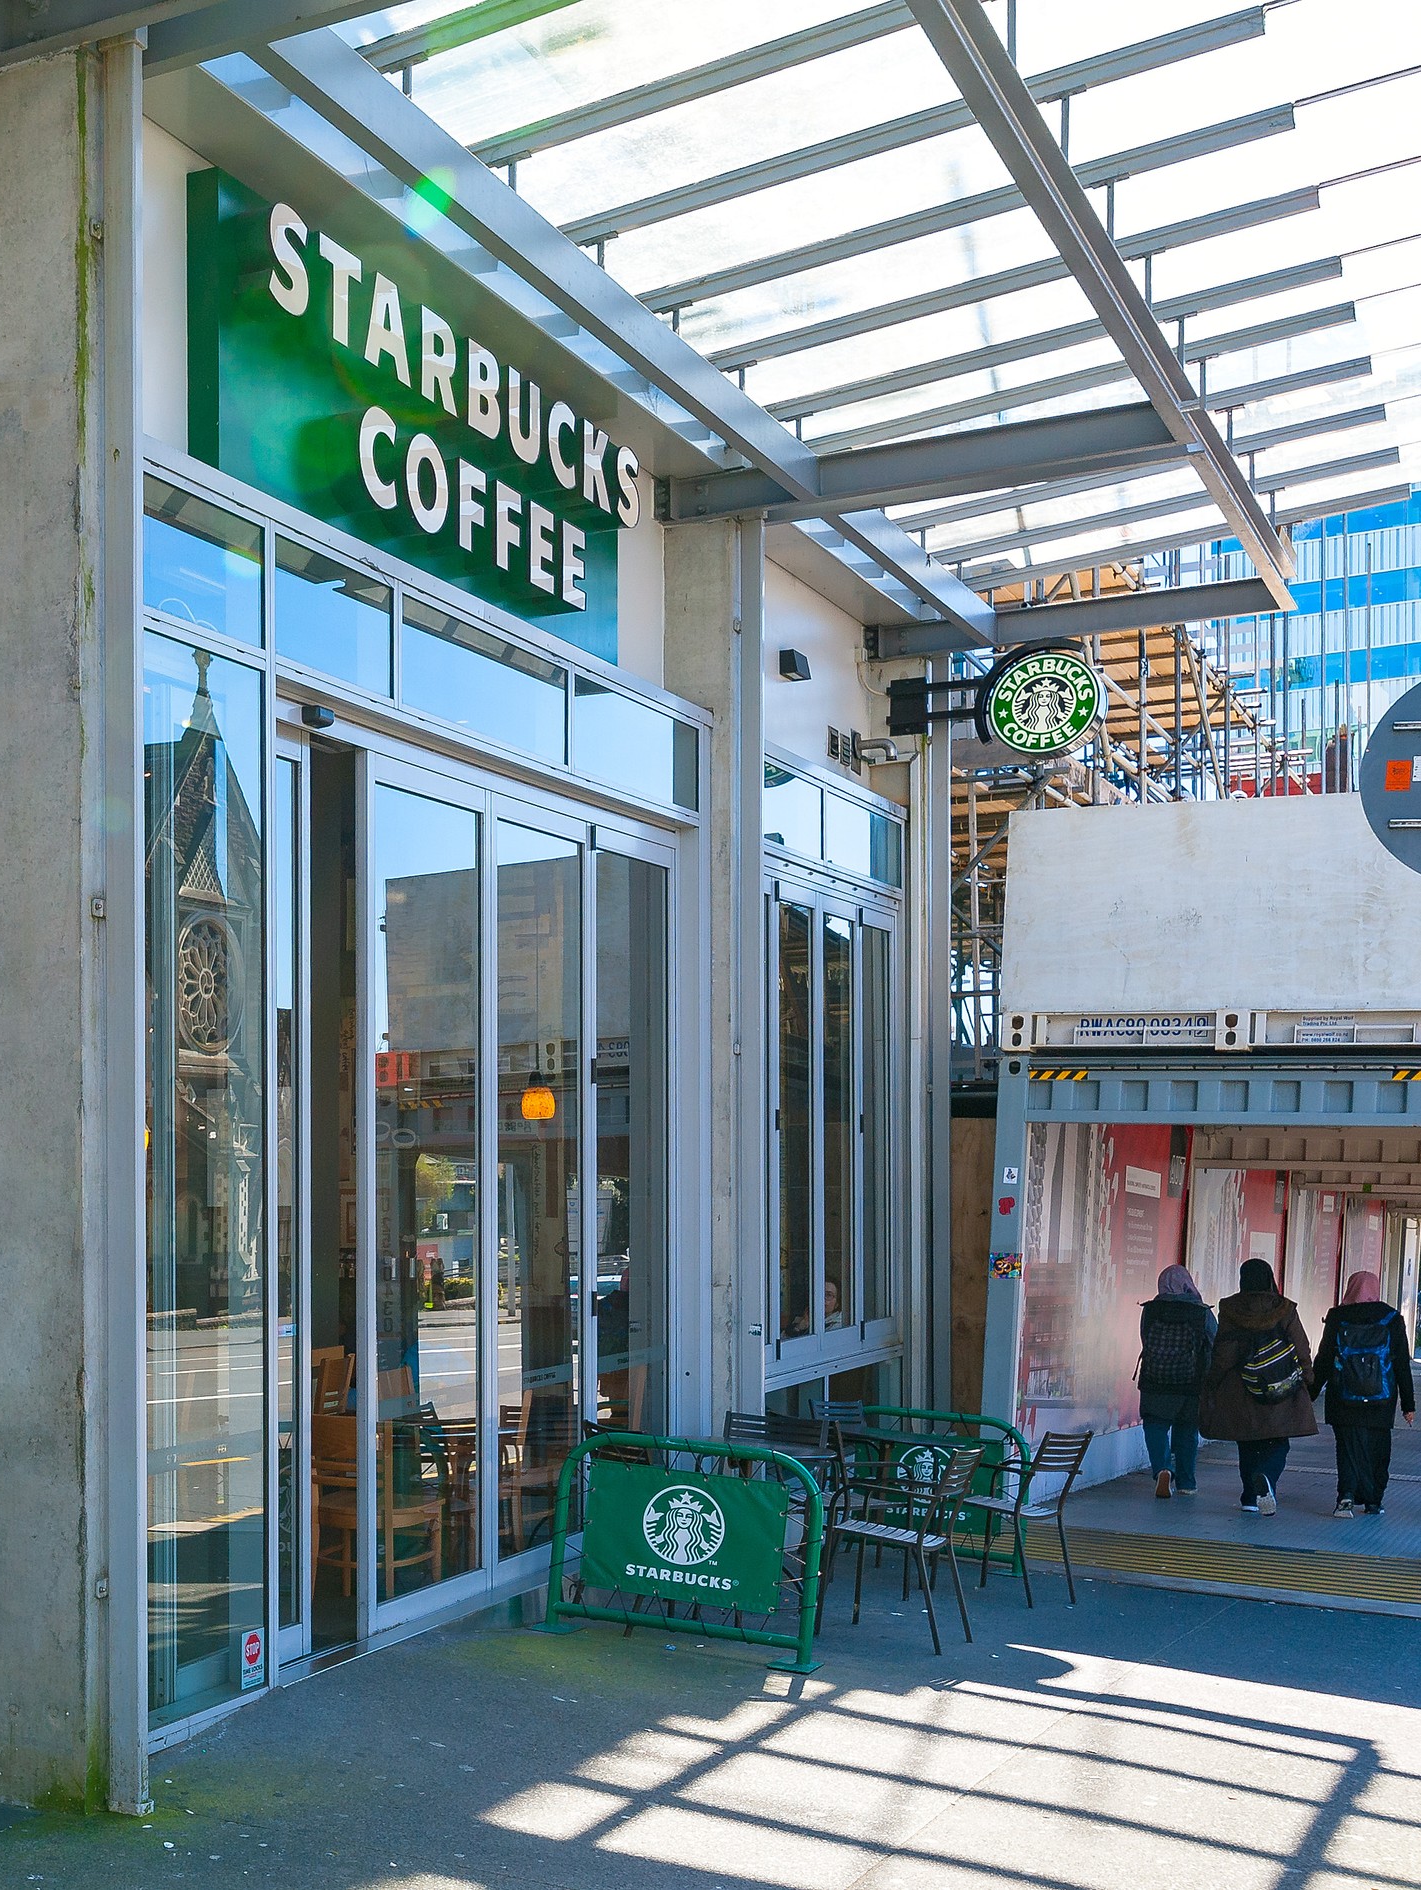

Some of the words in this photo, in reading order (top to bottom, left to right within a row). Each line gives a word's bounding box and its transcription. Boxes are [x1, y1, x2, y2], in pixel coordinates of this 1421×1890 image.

[268, 202, 640, 529] STARBUCKS
[358, 406, 587, 612] COFFEE
[997, 659, 1093, 702] STARBUCKS
[1003, 722, 1078, 748] COFFEE
[625, 1563, 732, 1591] STARBUCKS
[245, 1641, 260, 1657] STOP
